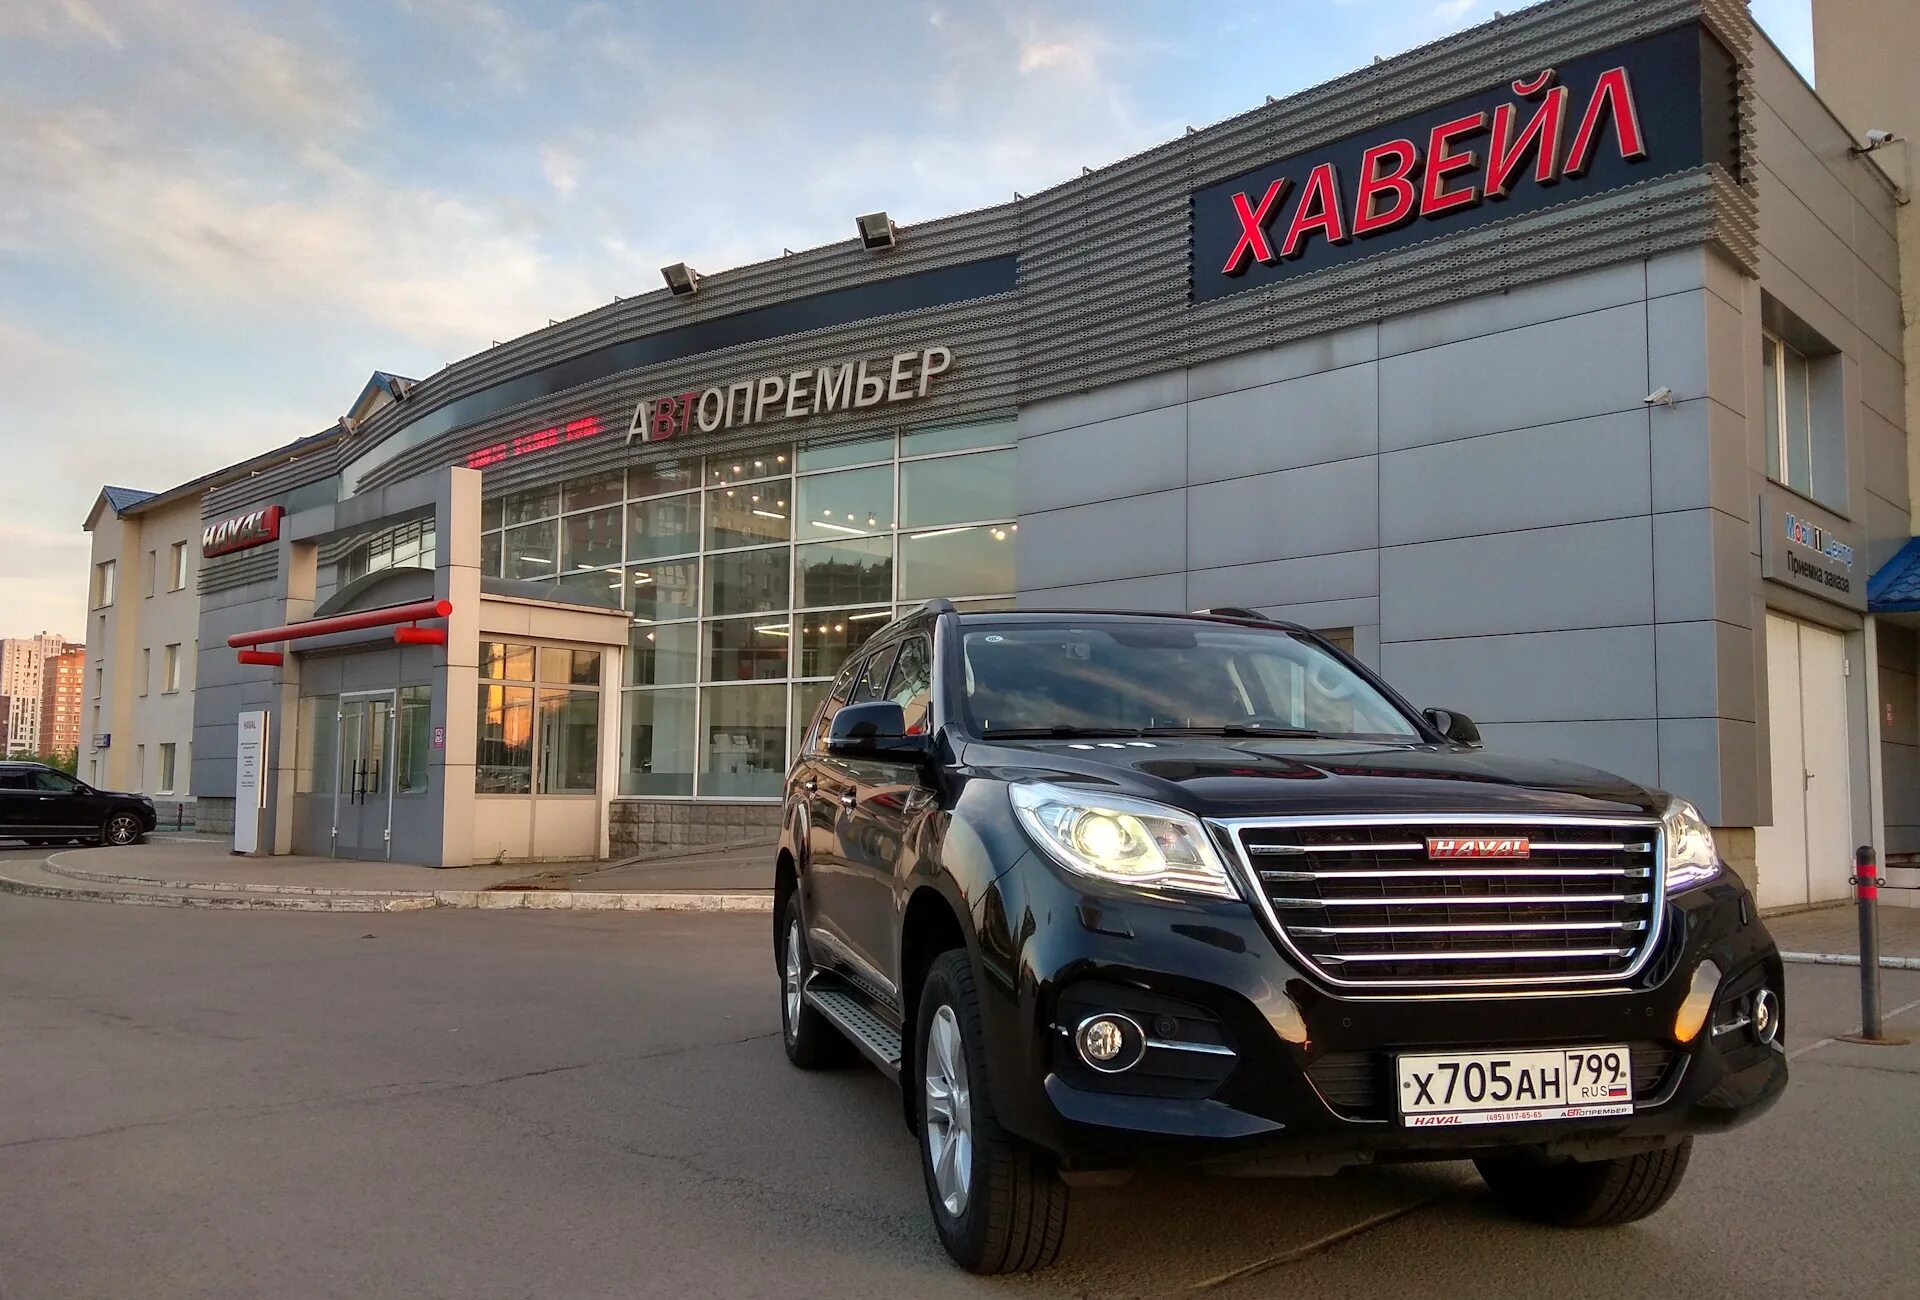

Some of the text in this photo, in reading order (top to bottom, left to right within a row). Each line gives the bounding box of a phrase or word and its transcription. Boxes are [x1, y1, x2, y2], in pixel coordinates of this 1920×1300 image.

[1222, 66, 1645, 277] ХАВЕЙЛ
[625, 346, 955, 446] АВТОПРЕМЬЕР
[202, 510, 271, 550] HAVAL
[1787, 550, 1850, 593] Приемка заказа
[1435, 840, 1529, 856] HAVAL
[1412, 1052, 1621, 1106] Х705АН 799
[1581, 1086, 1608, 1098] RUS
[1413, 1107, 1628, 1126] HAVAL (495) 817-65-65 АВТОПРЕМЬЕР
